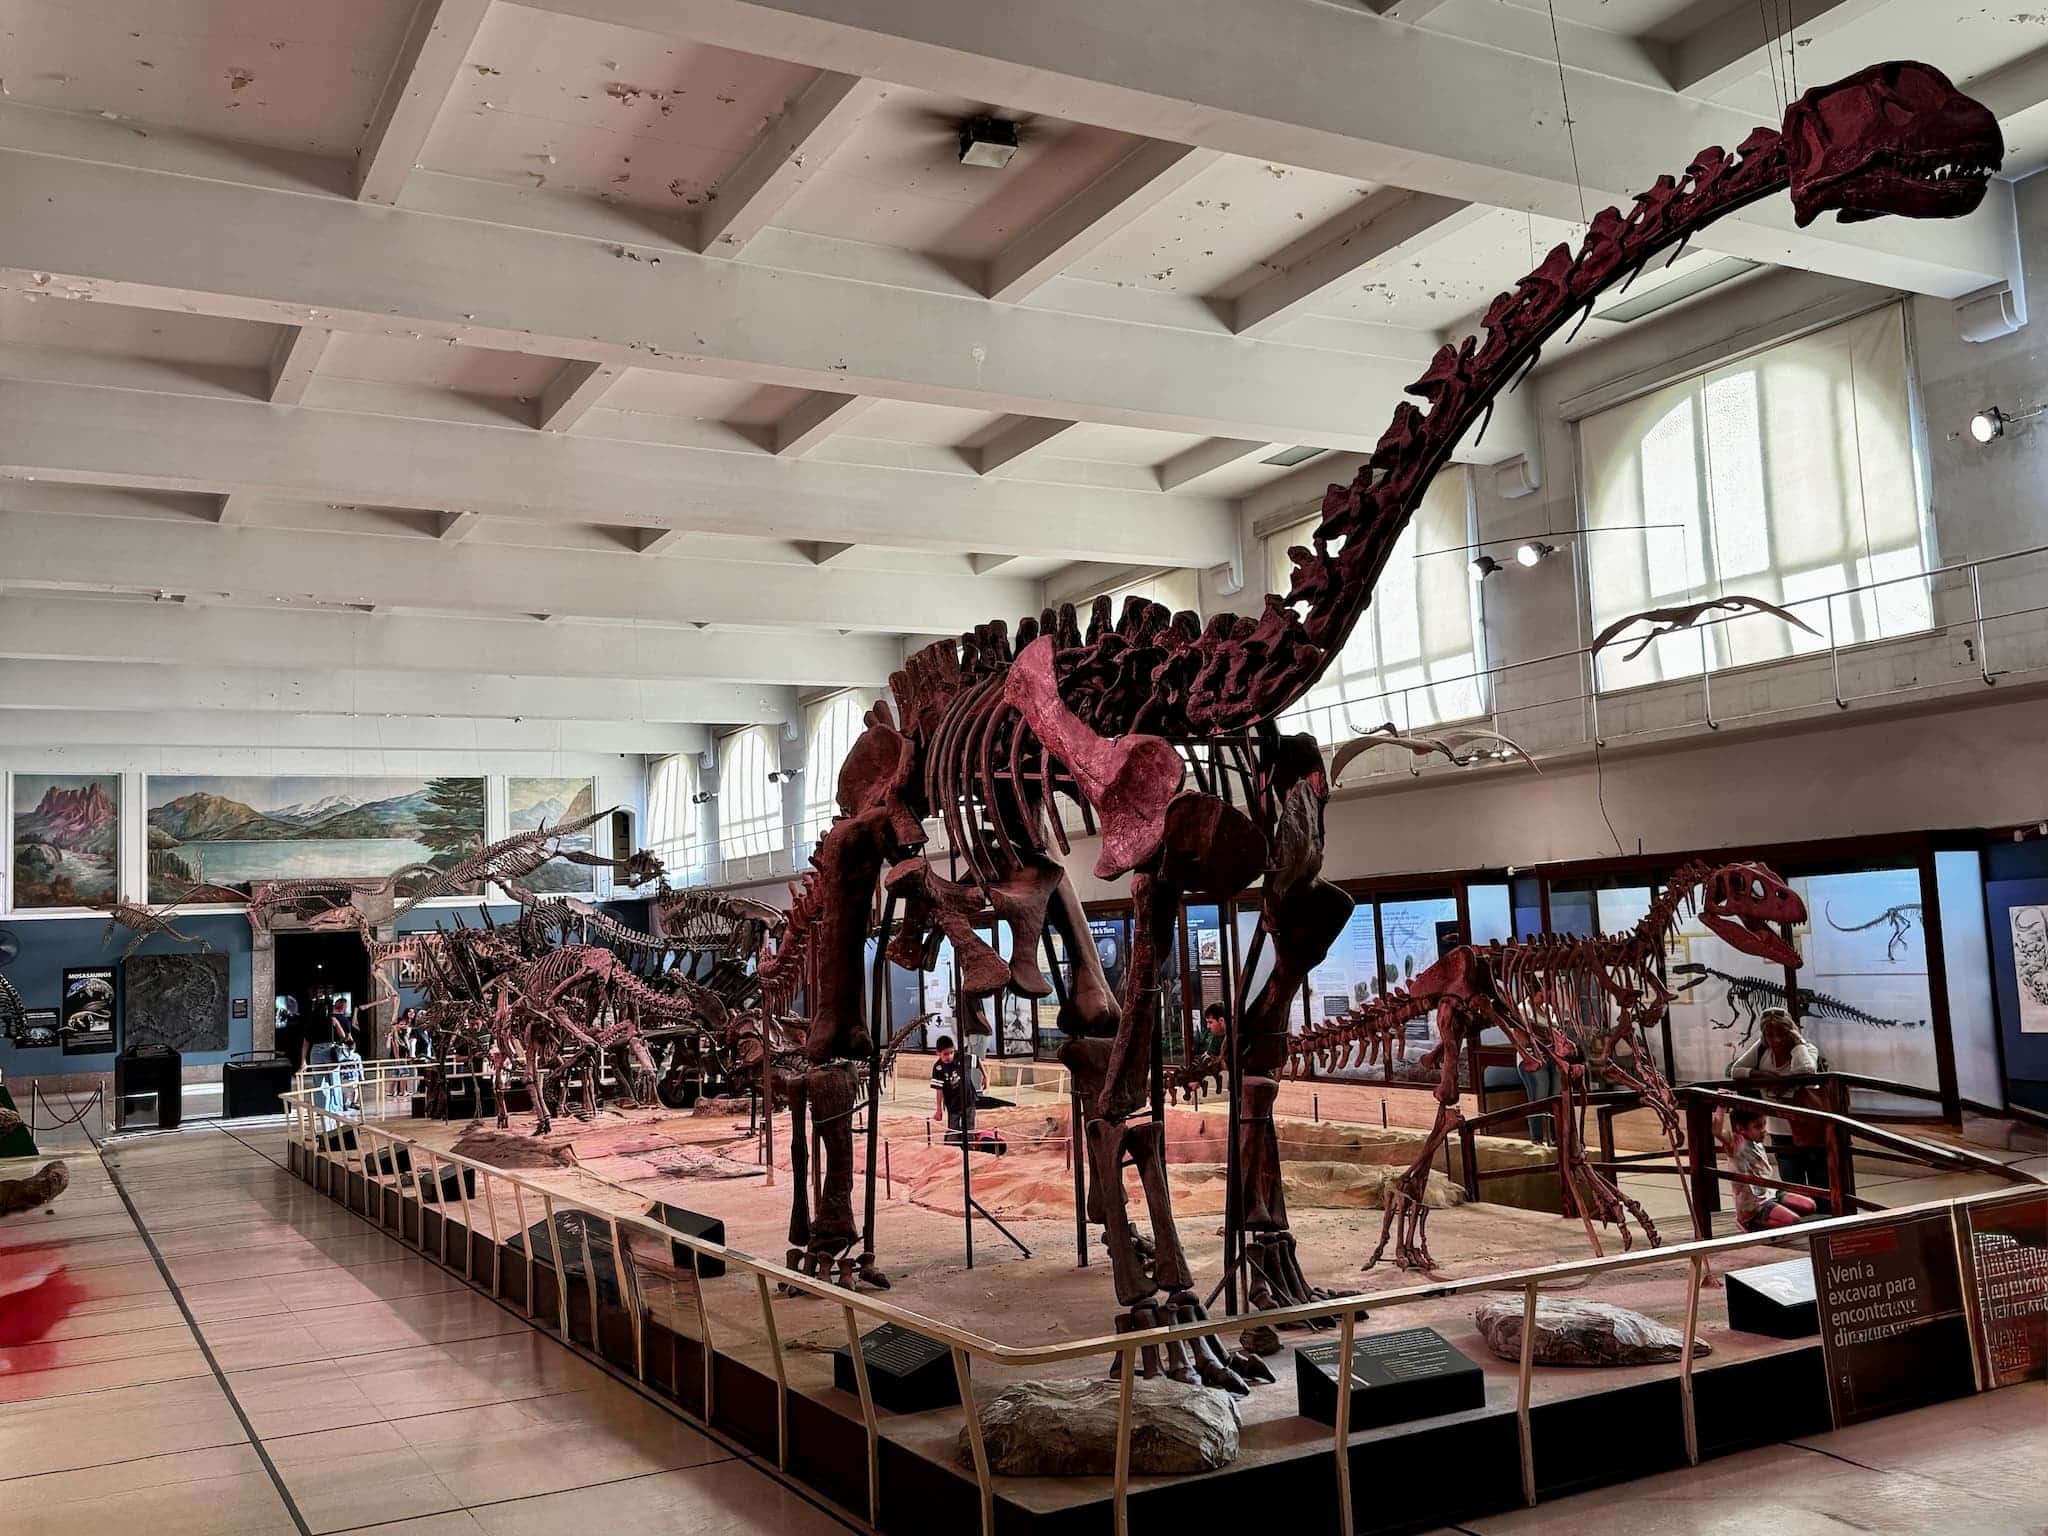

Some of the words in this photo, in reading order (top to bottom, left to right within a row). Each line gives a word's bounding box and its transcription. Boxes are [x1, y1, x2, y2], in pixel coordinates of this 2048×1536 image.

[1826, 1257, 1862, 1289] ¡Vení
[1866, 1263, 1875, 1278] a
[1828, 1283, 1881, 1305] excavar
[1886, 1276, 1917, 1299] para
